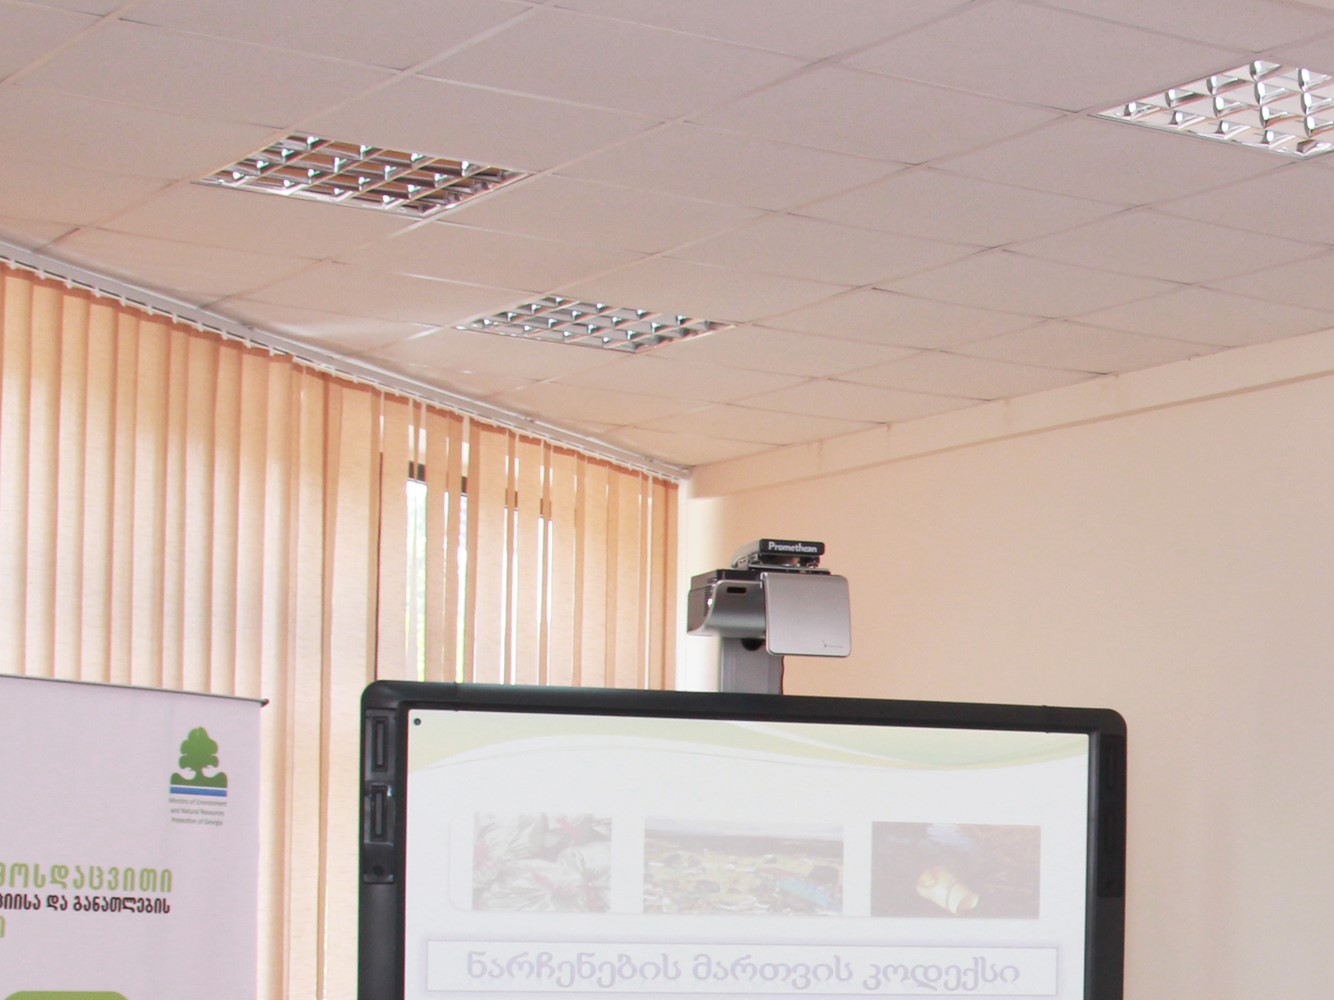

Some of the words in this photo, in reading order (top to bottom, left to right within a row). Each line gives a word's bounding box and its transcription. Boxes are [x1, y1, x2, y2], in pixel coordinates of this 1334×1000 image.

[768, 541, 818, 553] Promethean
[0, 862, 173, 893] ოსდაცვითი
[46, 894, 68, 911] და
[73, 895, 171, 914] განათლების
[466, 950, 682, 988] ნარჩენების
[692, 953, 853, 990] მართვის
[862, 956, 1020, 991] კოდექსი
